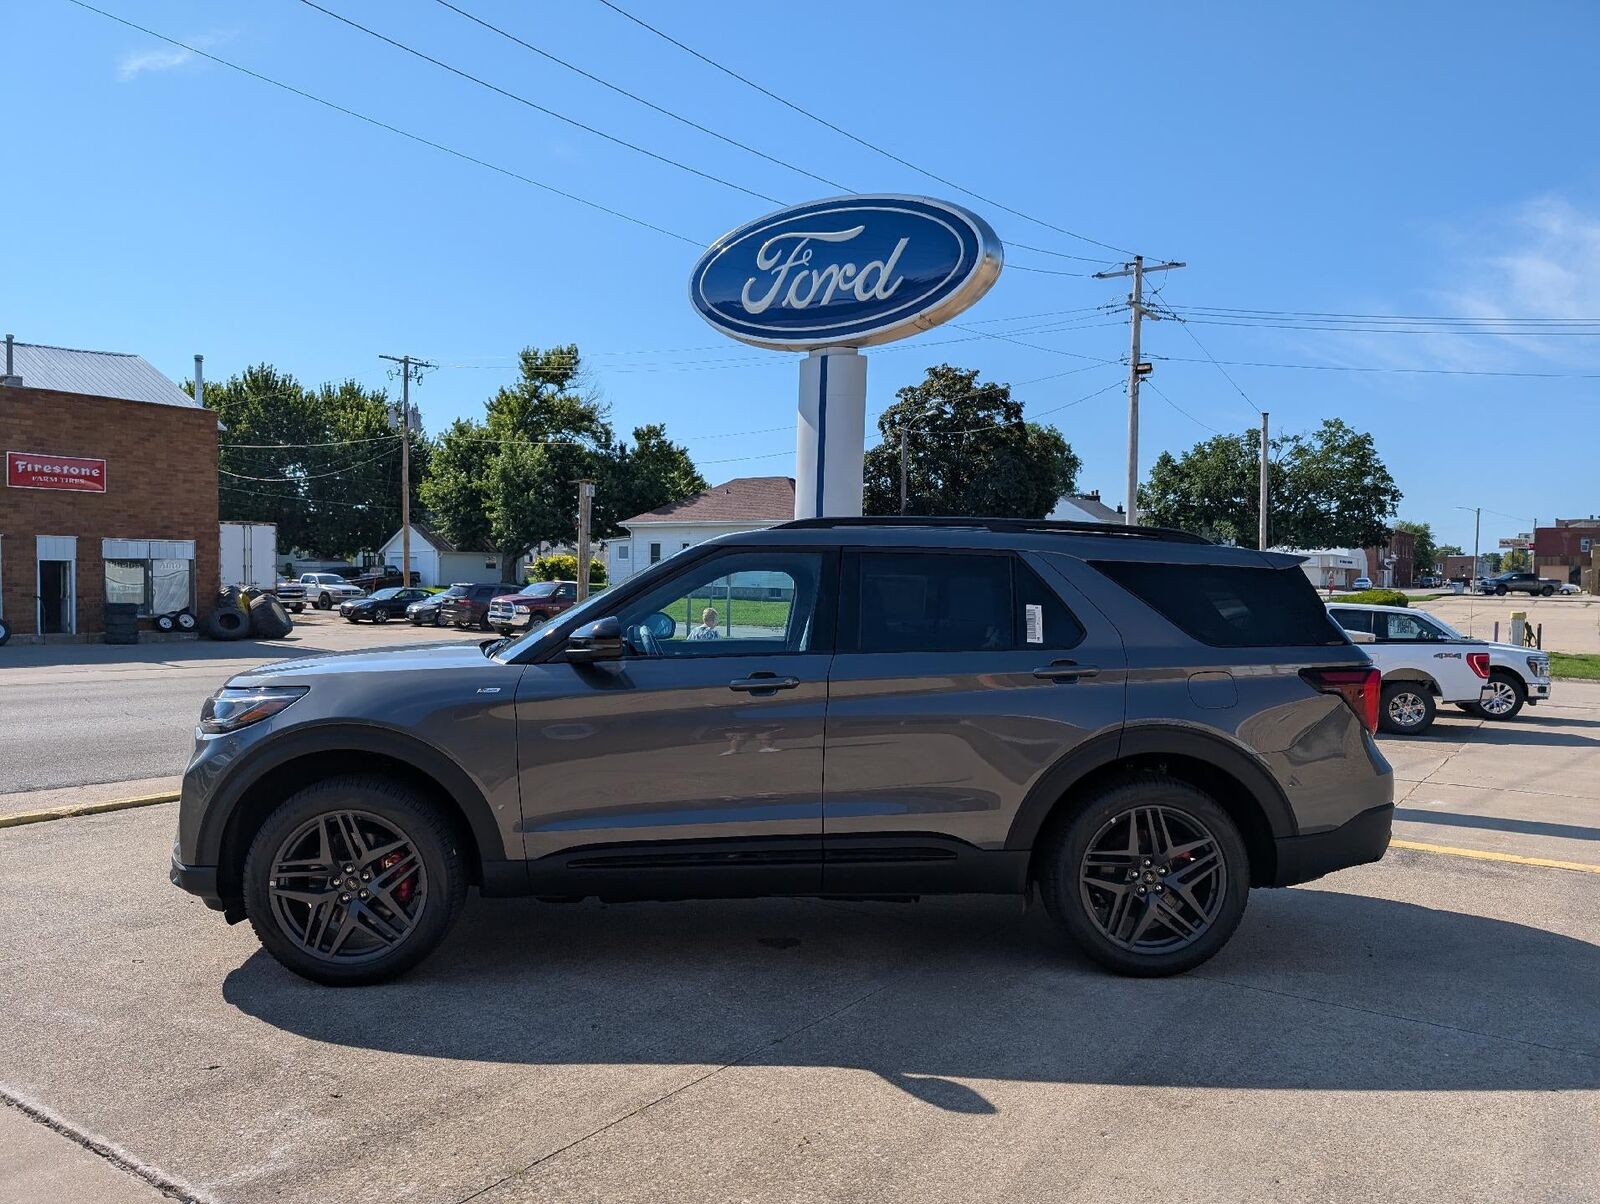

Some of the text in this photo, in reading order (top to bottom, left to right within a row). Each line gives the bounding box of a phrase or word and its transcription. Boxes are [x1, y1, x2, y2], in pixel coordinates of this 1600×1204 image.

[741, 224, 910, 315] Ford
[15, 460, 101, 477] Firestone
[31, 475, 58, 483] FARM
